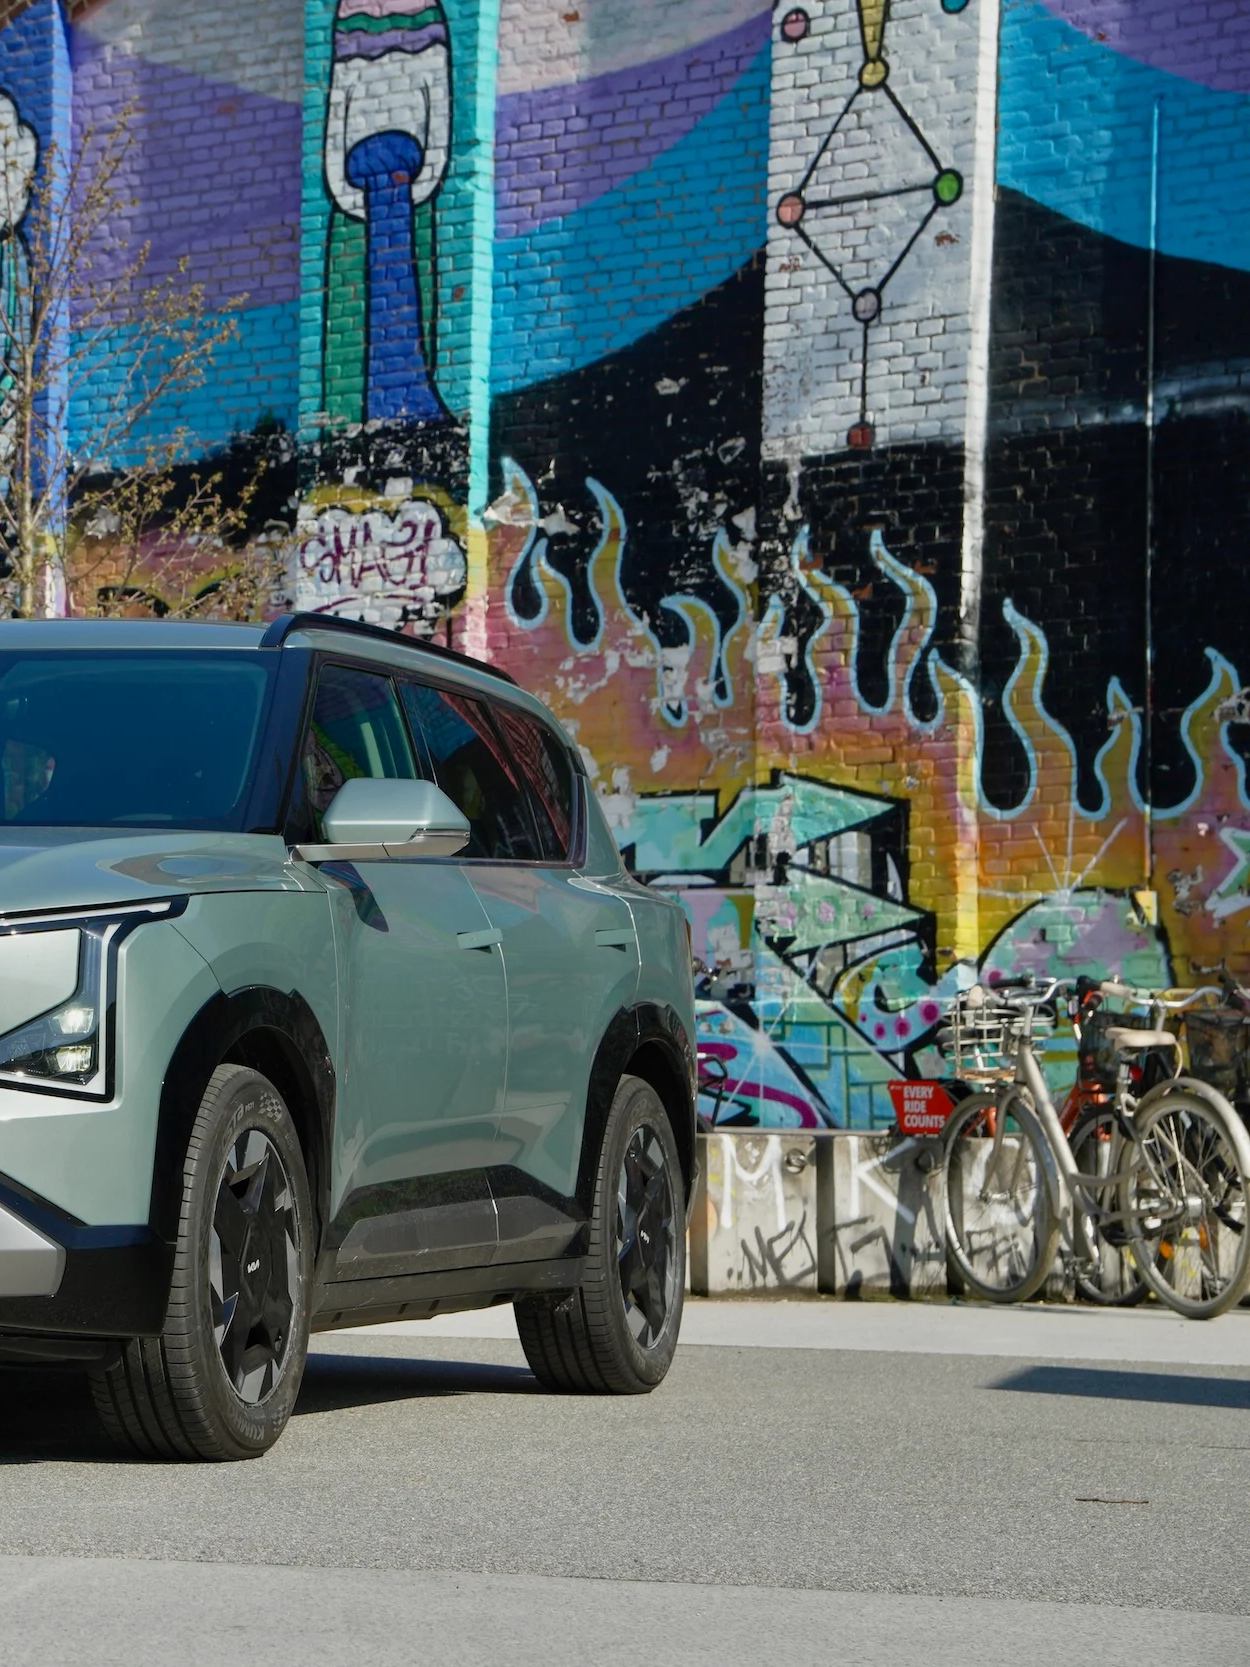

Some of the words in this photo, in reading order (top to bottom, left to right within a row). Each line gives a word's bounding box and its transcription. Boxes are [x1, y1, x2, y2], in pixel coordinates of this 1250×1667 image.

[903, 1086, 934, 1099] EVERY
[903, 1100, 927, 1113] RIDE
[904, 1114, 946, 1128] COUNTS
